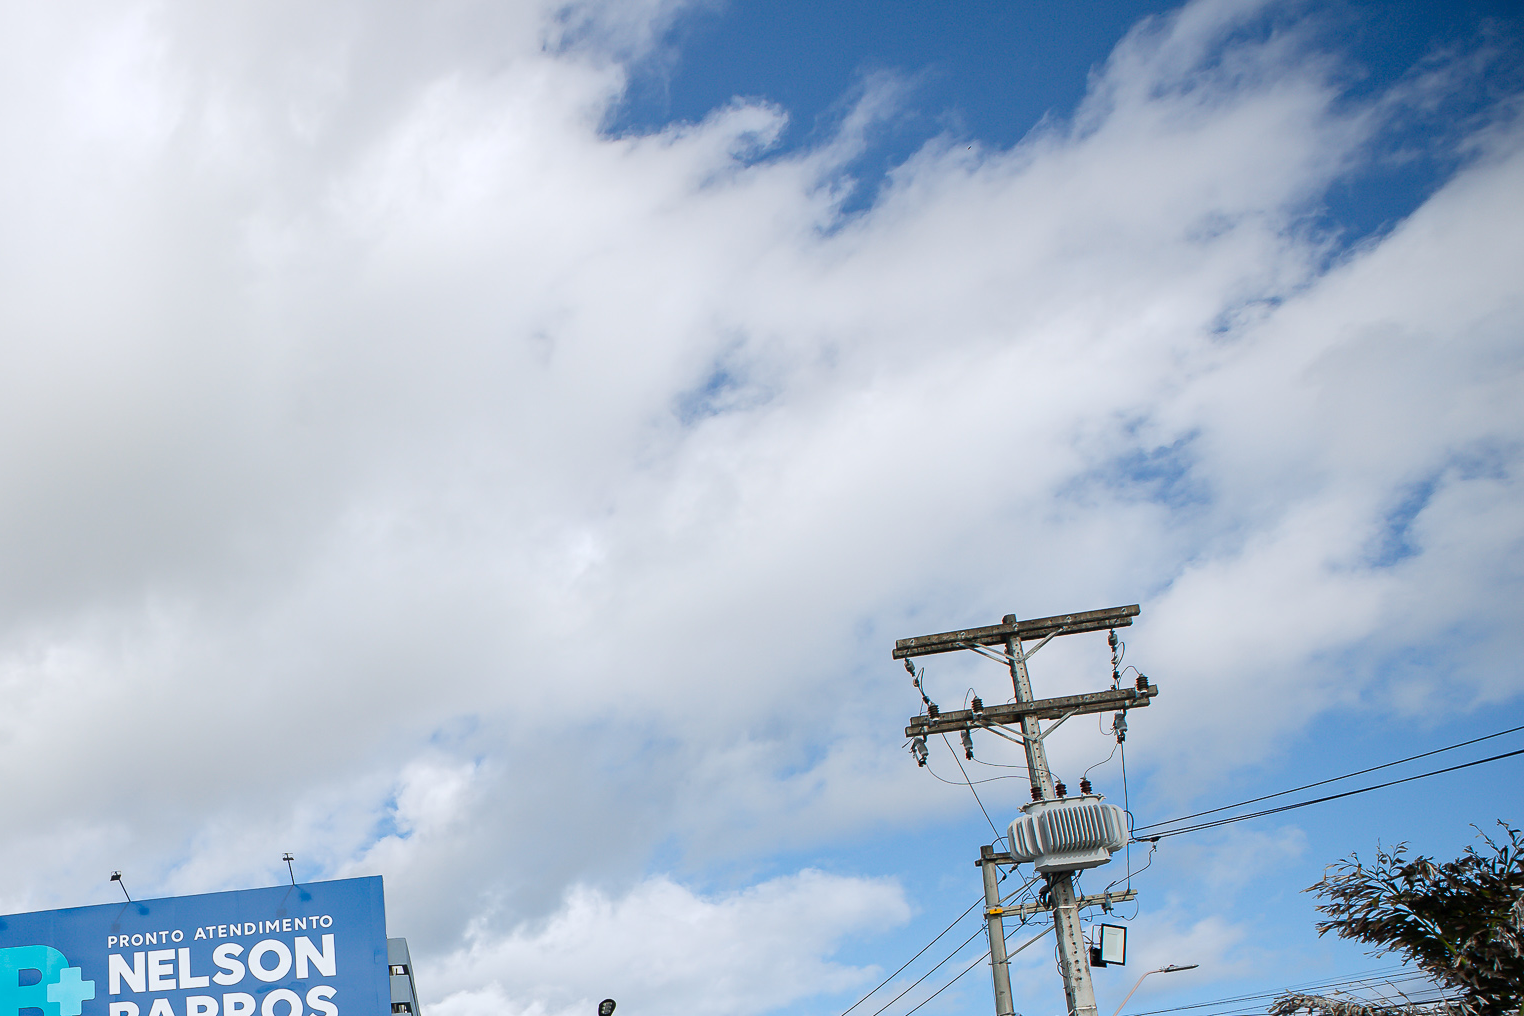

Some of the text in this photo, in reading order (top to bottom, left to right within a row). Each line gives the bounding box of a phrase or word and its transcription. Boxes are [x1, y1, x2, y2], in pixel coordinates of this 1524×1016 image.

[107, 914, 334, 949] PRONTO ATENDIMENTO
[108, 933, 337, 996] NELSON
